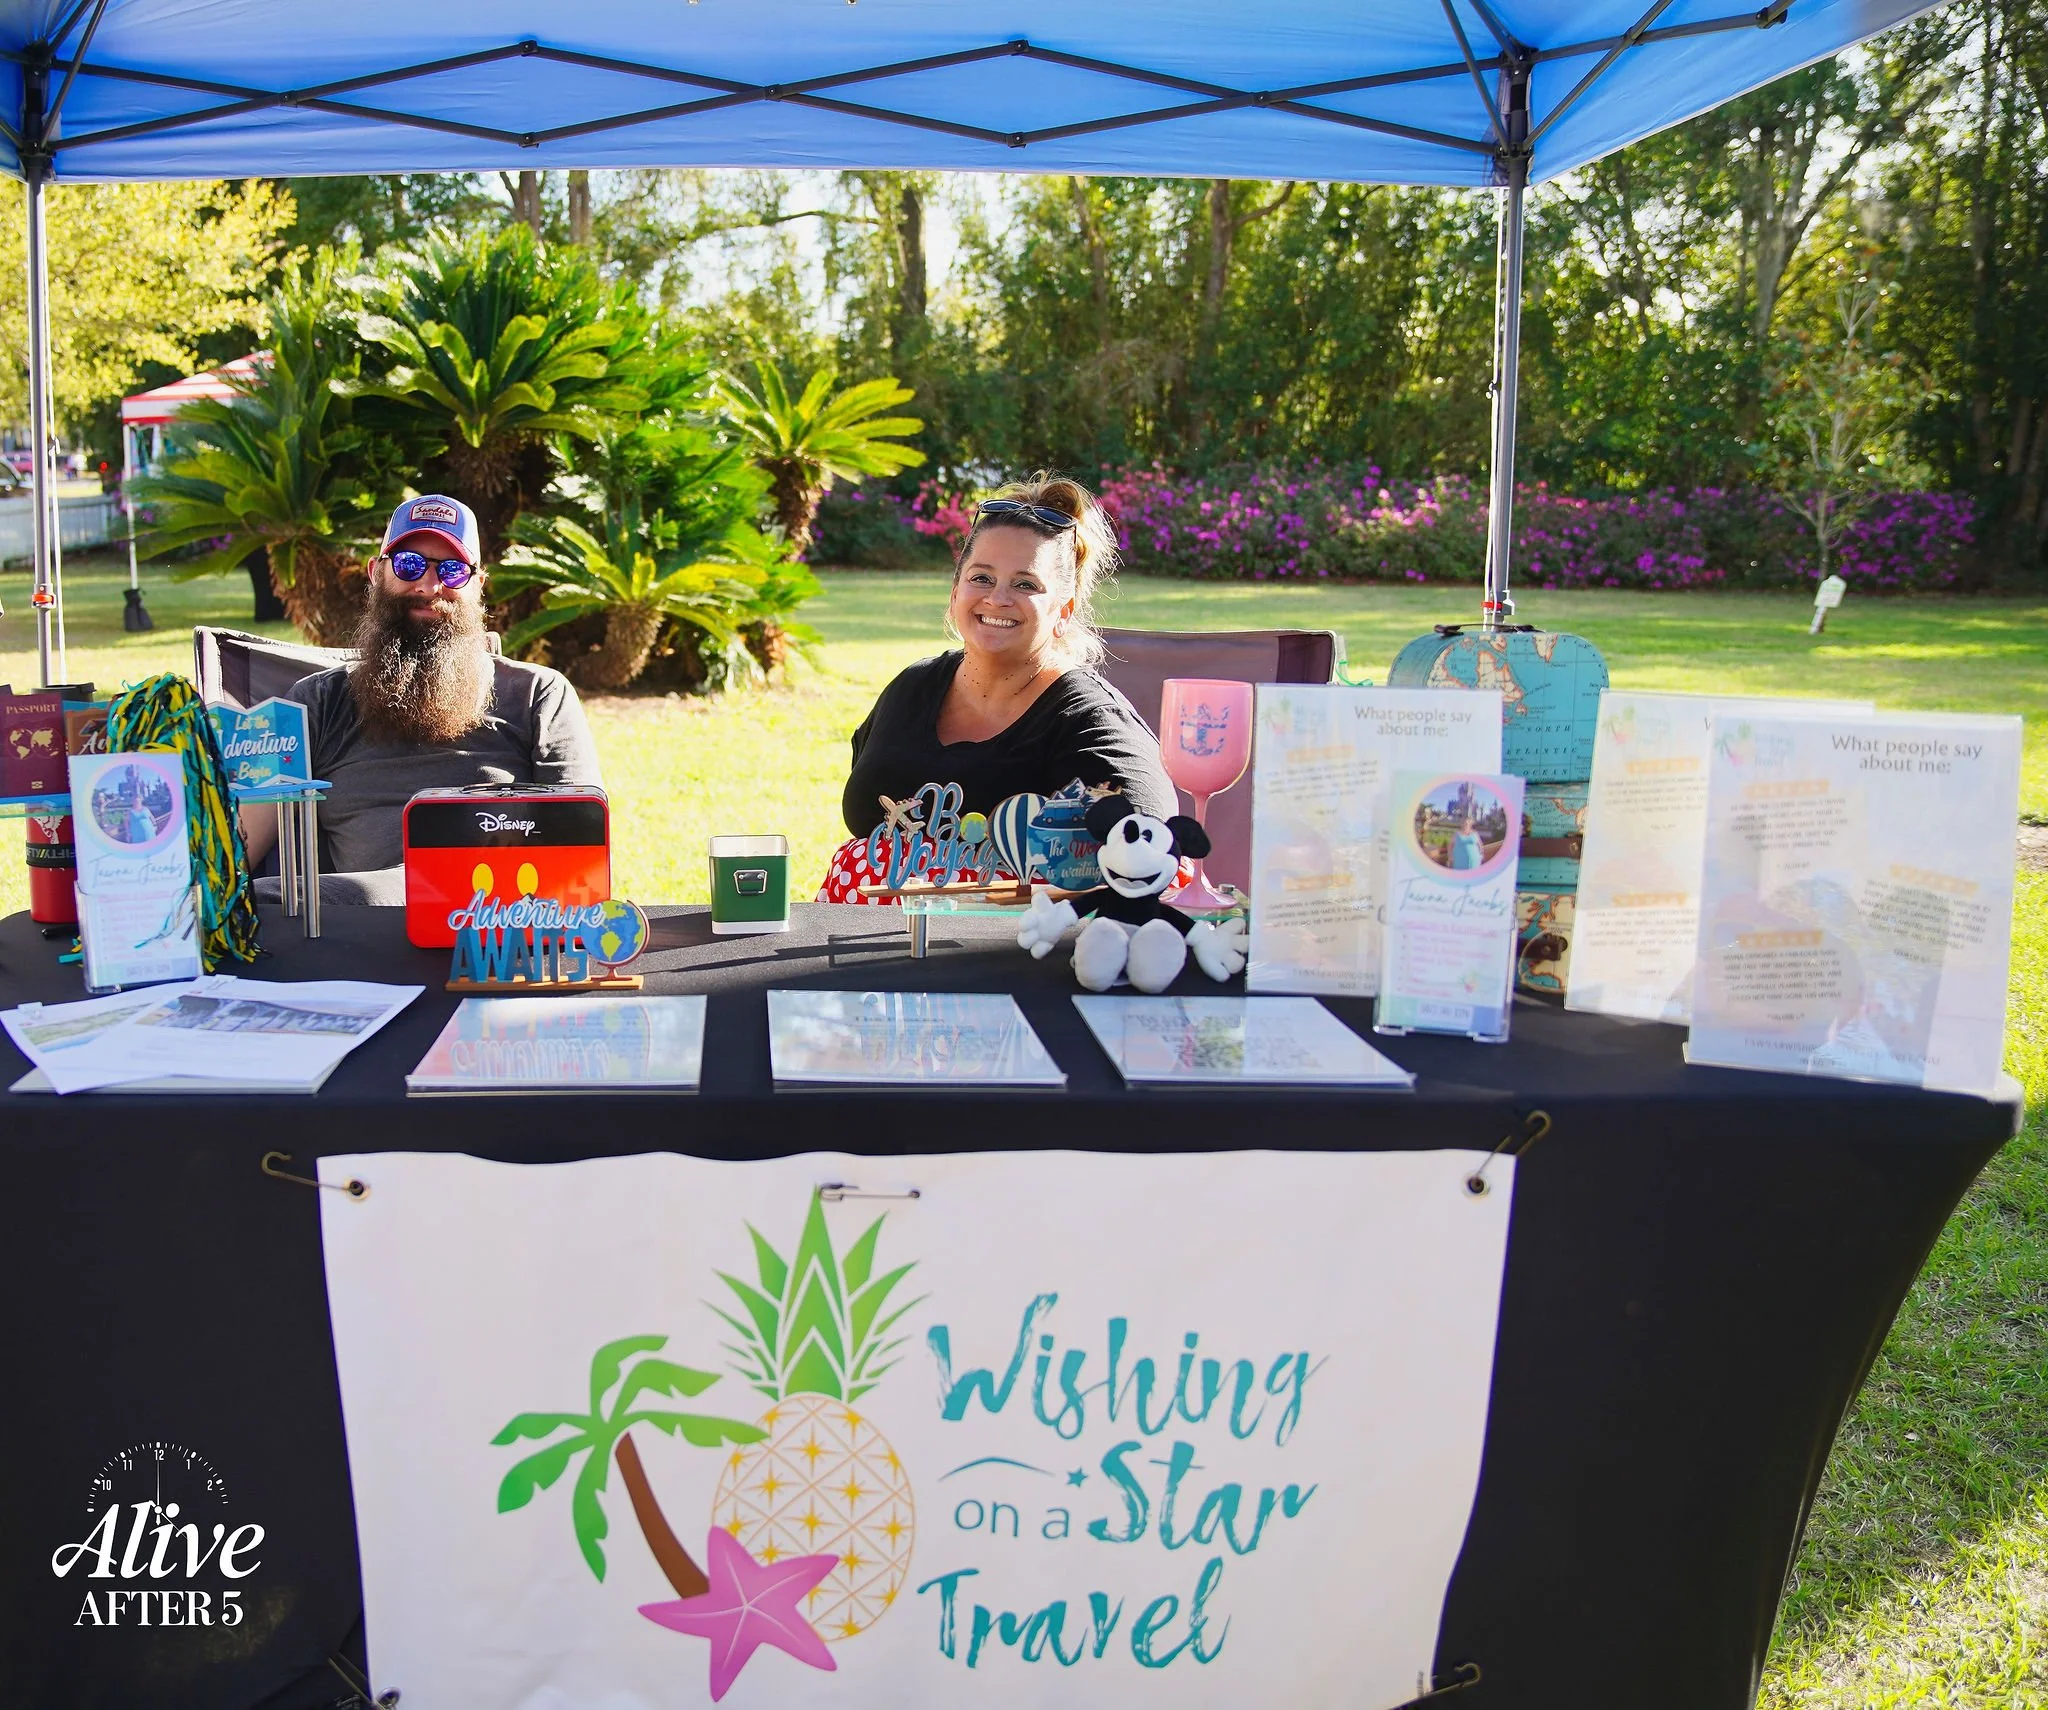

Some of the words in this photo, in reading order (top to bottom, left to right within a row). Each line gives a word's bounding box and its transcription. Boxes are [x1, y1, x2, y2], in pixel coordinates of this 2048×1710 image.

[6, 703, 58, 715] PASSPORT
[1354, 706, 1393, 721] What
[1397, 709, 1447, 725] people
[1450, 711, 1473, 725] say
[235, 714, 251, 731] Let
[1377, 723, 1418, 737] about
[1831, 733, 1879, 752] What
[1885, 738, 1949, 758] people
[1954, 743, 1984, 760] say
[1859, 754, 1912, 772] about
[1918, 760, 1952, 774] me:
[475, 812, 536, 837] Disney
[1043, 836, 1065, 858] The
[1046, 865, 1056, 880] is
[448, 888, 605, 931] Adventure
[450, 926, 590, 983] AWAITS
[927, 1291, 1331, 1448] Wishing
[954, 1499, 1019, 1538] on
[1041, 1506, 1070, 1540] a
[1087, 1440, 1319, 1556] Star
[917, 1556, 1231, 1669] Travel
